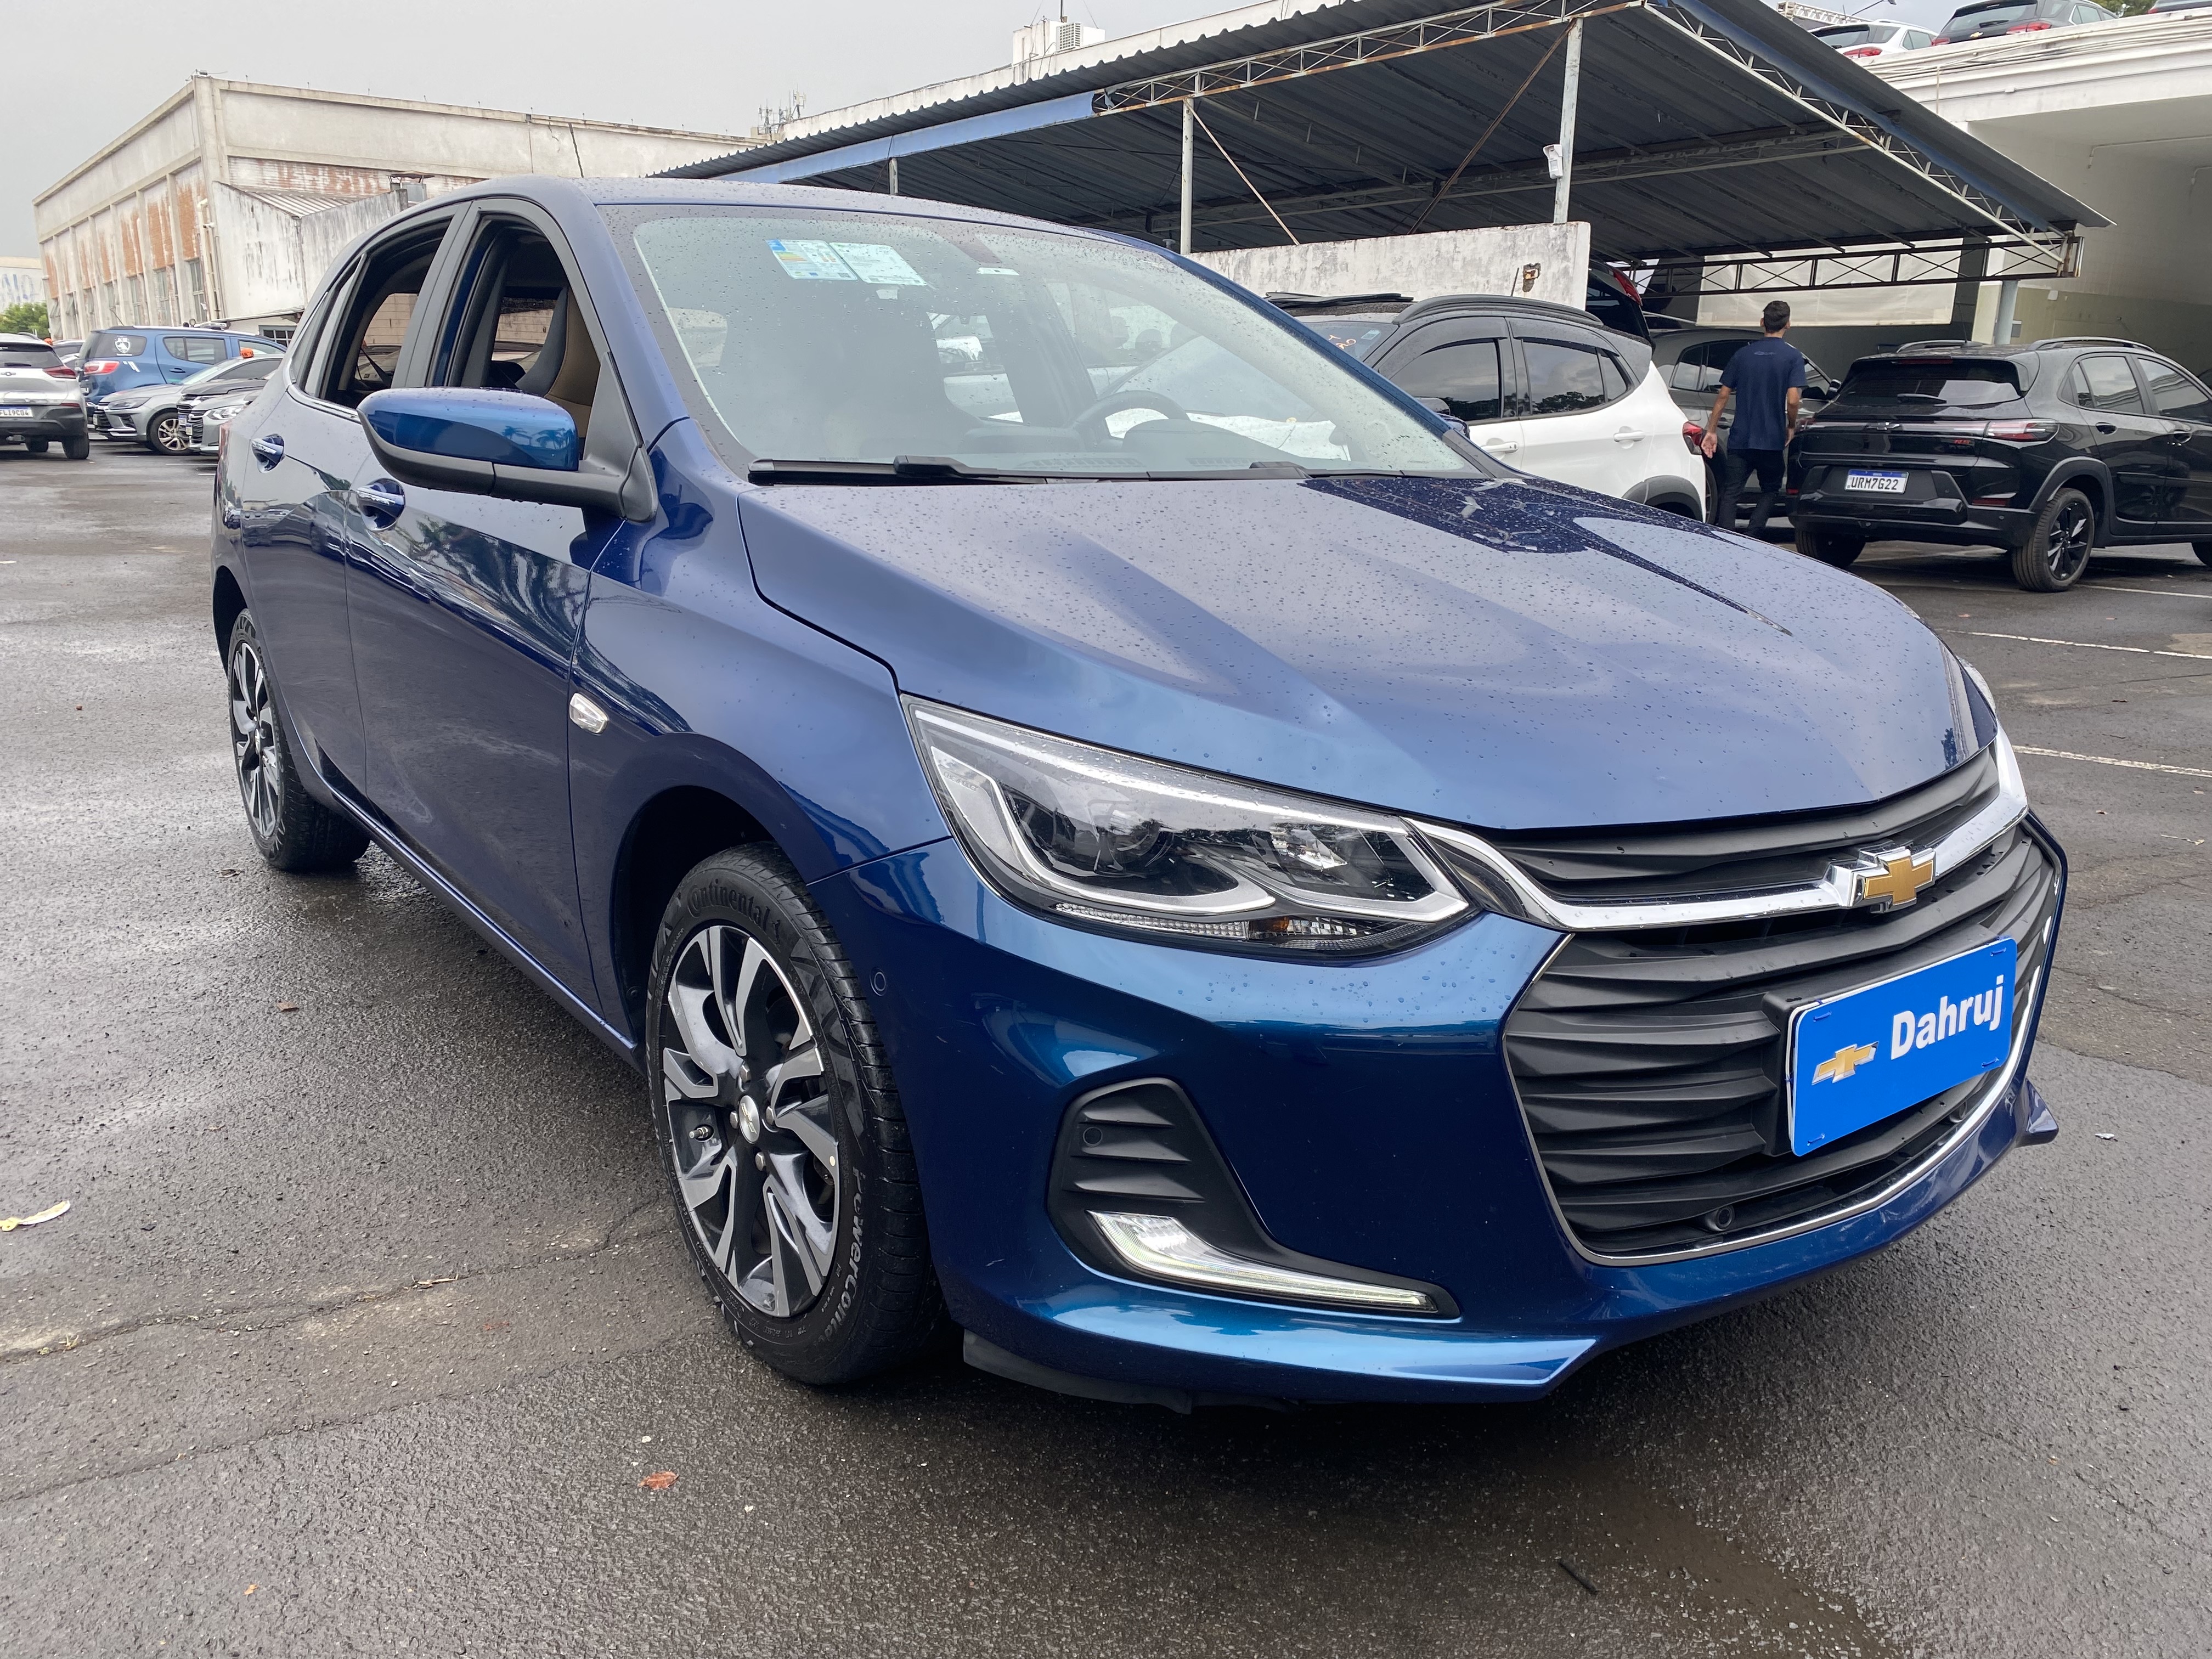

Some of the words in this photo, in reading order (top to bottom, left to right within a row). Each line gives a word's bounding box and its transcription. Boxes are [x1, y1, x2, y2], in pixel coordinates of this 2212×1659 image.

[1851, 477, 1899, 490] URM7G22
[687, 878, 770, 934] Continental
[1891, 975, 2004, 1060] Dahruj
